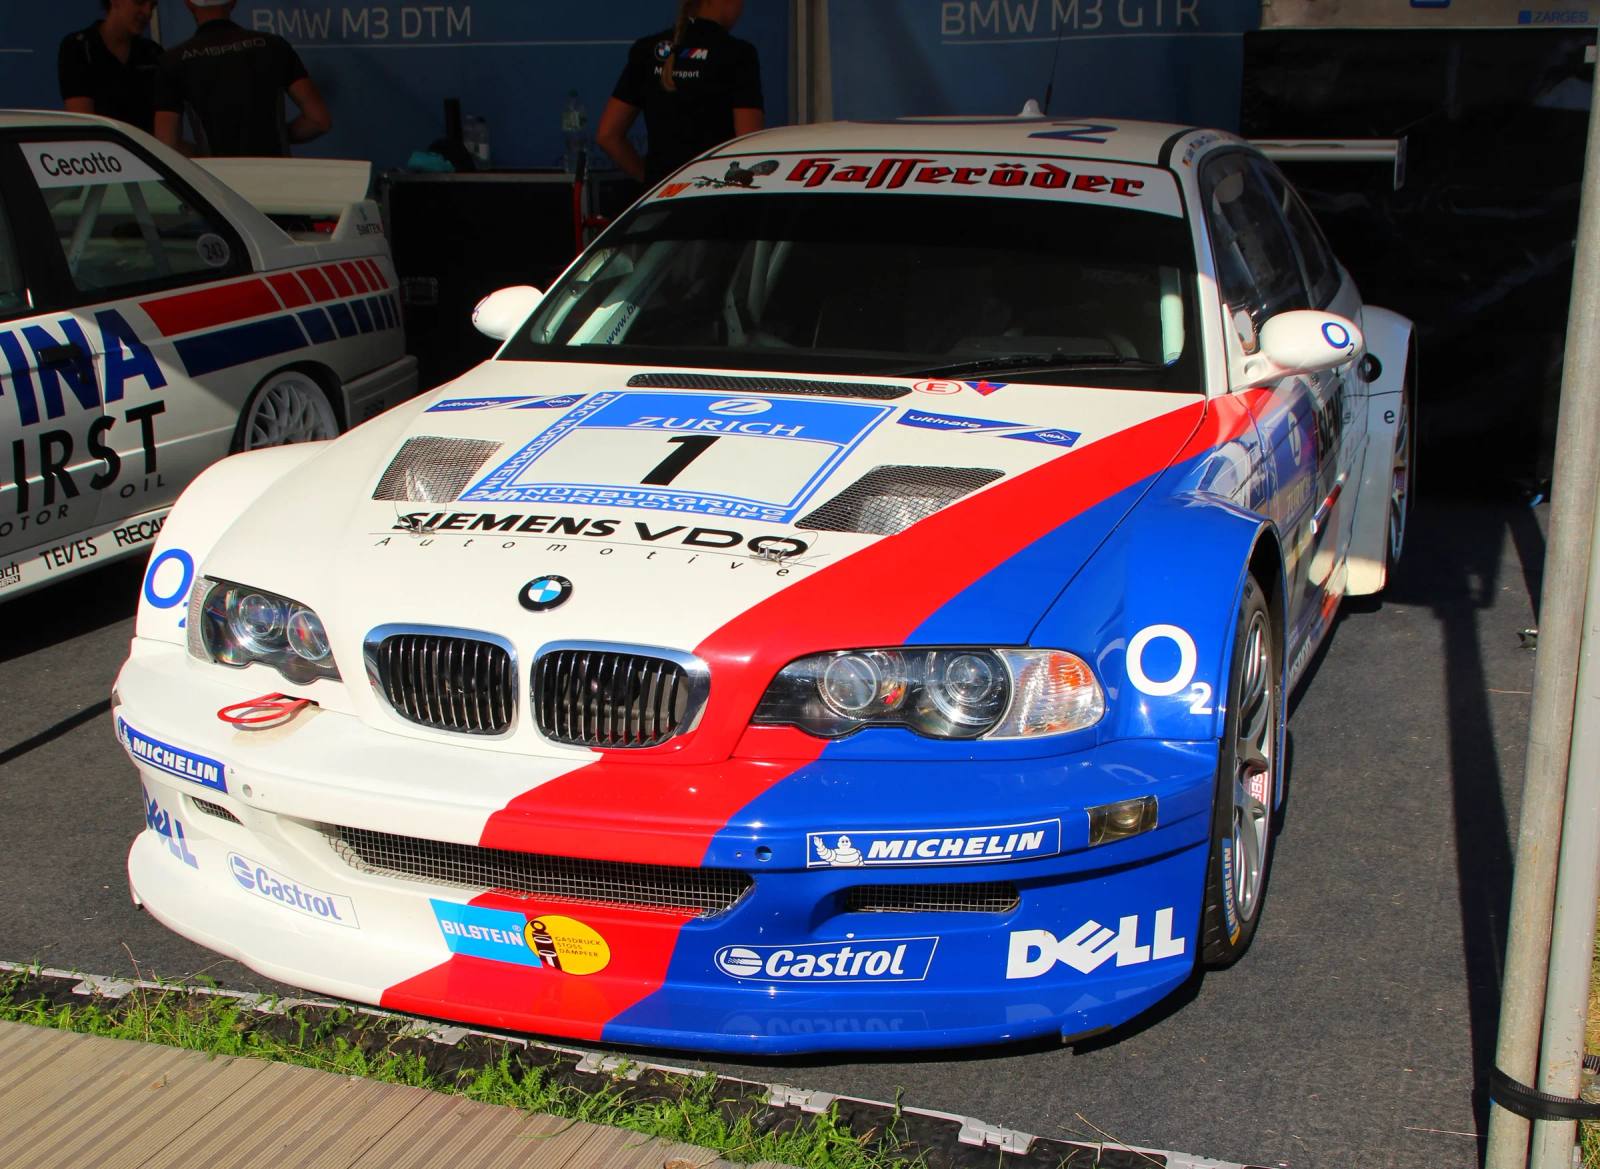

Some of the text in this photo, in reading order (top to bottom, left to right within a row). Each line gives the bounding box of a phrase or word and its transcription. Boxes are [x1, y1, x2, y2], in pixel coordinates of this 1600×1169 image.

[252, 6, 471, 40] BMW M3 DTM
[941, 0, 1037, 35] BMW
[1051, 0, 1104, 31] M3
[1534, 11, 1589, 24] ZARGES
[40, 151, 122, 176] Cecotto
[0, 309, 168, 426] INA
[629, 417, 805, 437] ZURICH
[909, 415, 982, 428] ultimate
[640, 434, 722, 486] 1
[120, 474, 165, 498] OIL
[469, 487, 787, 516] 24h NÜRBURGRING
[518, 496, 783, 521] NORDSCHLEIFE
[392, 512, 808, 557] SIEMENS VDO
[39, 536, 98, 570] TEVES
[374, 536, 790, 577] Automotive
[1126, 625, 1213, 715] O2
[132, 736, 219, 783] MICHELIN
[867, 830, 1045, 862] MICHELIN
[255, 867, 343, 921] Castrol
[440, 919, 525, 947] BILSTEIN
[555, 936, 601, 946] GASDRUCK
[557, 942, 583, 950] STOSS
[1006, 907, 1186, 980] DELL
[765, 944, 907, 977] Castrol
